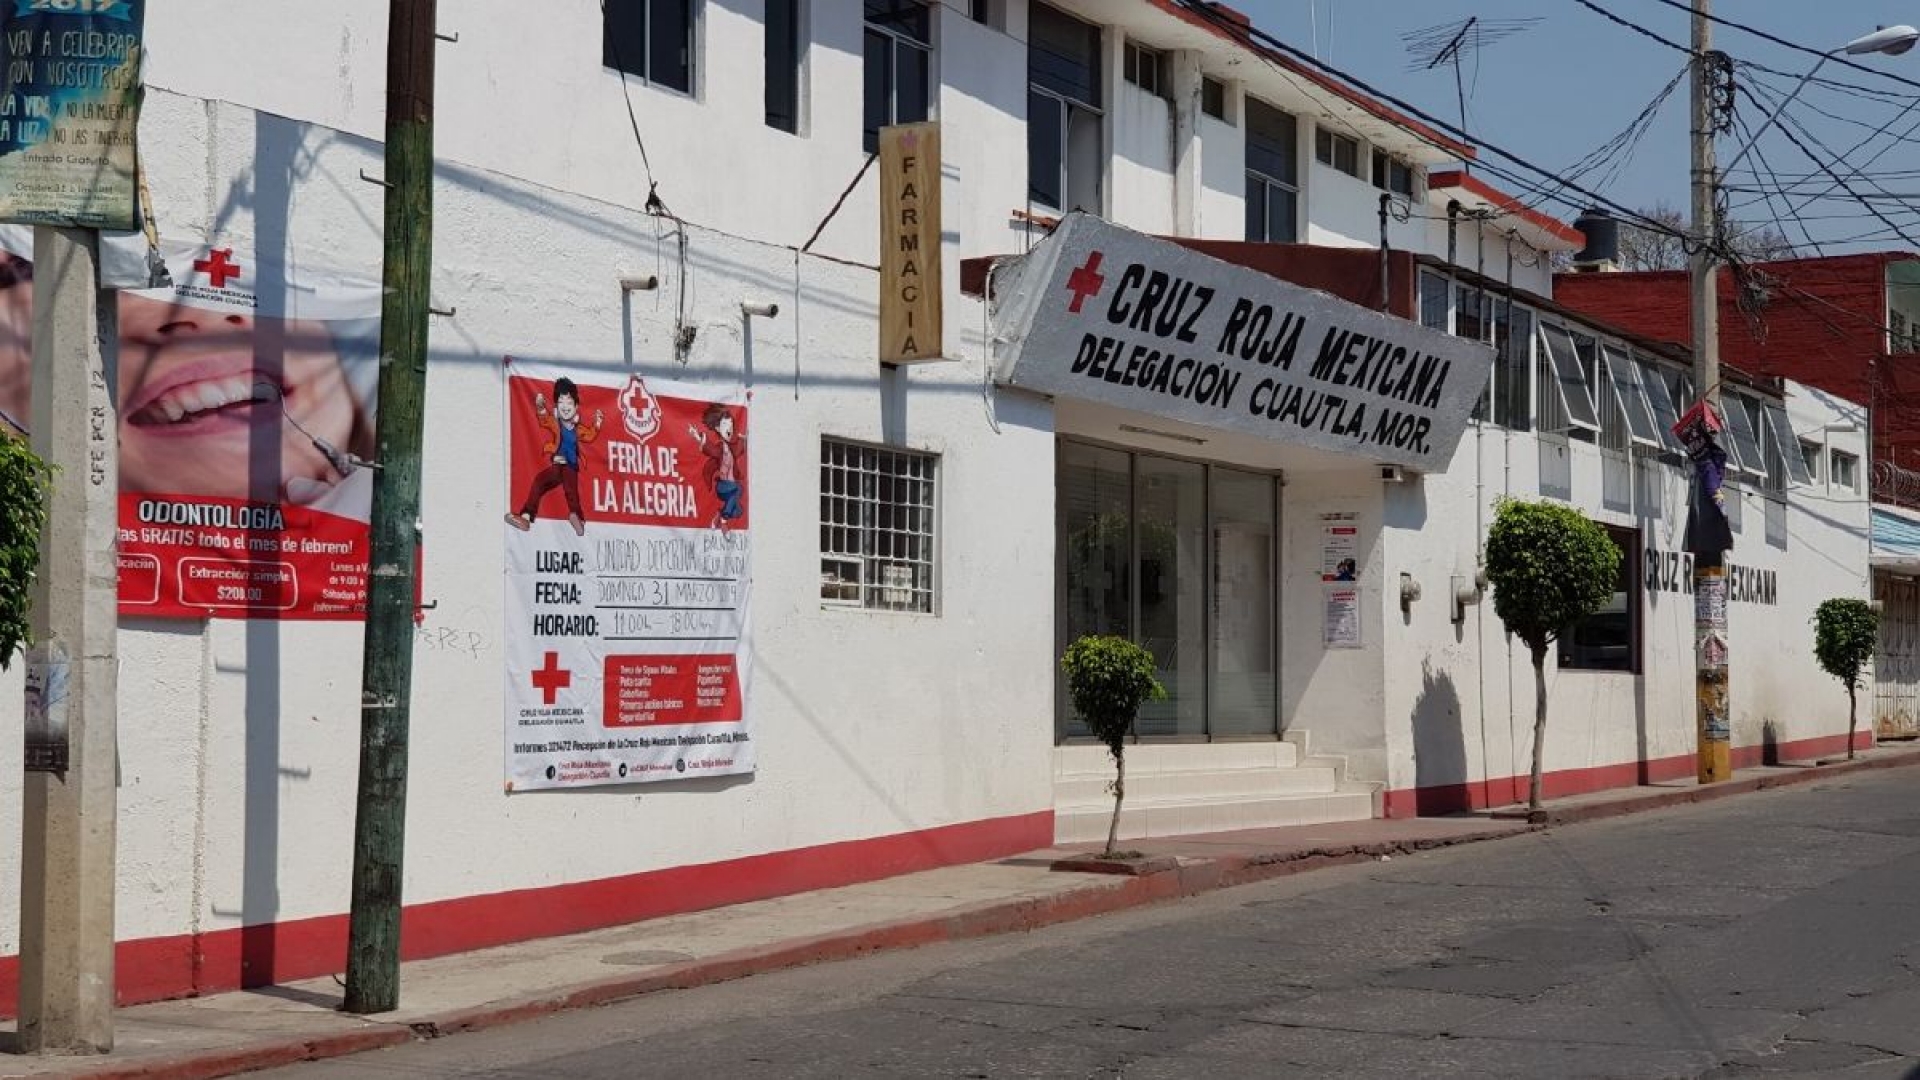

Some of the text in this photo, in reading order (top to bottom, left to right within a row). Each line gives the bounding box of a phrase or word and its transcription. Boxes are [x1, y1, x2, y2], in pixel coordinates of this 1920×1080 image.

[8, 30, 33, 56] VEN
[42, 30, 52, 56] A
[54, 128, 66, 144] NO
[900, 156, 918, 354] FARMACIA
[1107, 263, 1451, 409] CRUZ ROJA MEXICANA
[1070, 332, 1240, 408] DELEGACIÓN
[1371, 401, 1431, 454] MOR.
[91, 450, 105, 486] CFE
[607, 440, 679, 477] FERIA DE
[593, 476, 698, 518] LA ALEGRÍA
[138, 500, 284, 530] ODONTOLOGÍA
[142, 528, 195, 546] GRATIS
[198, 531, 230, 549] todo
[234, 534, 245, 550] el
[250, 538, 278, 551] mes
[282, 536, 297, 552] de
[301, 537, 353, 553] febrero!
[331, 562, 354, 572] Lunes
[535, 550, 584, 574] LUGAR:
[1644, 549, 1679, 592] CRUZ
[190, 565, 291, 585] Extracción simple
[217, 586, 262, 601] $200.00
[535, 582, 582, 605] FECHA:
[652, 580, 670, 605] 31
[533, 614, 599, 637] HORARIO:
